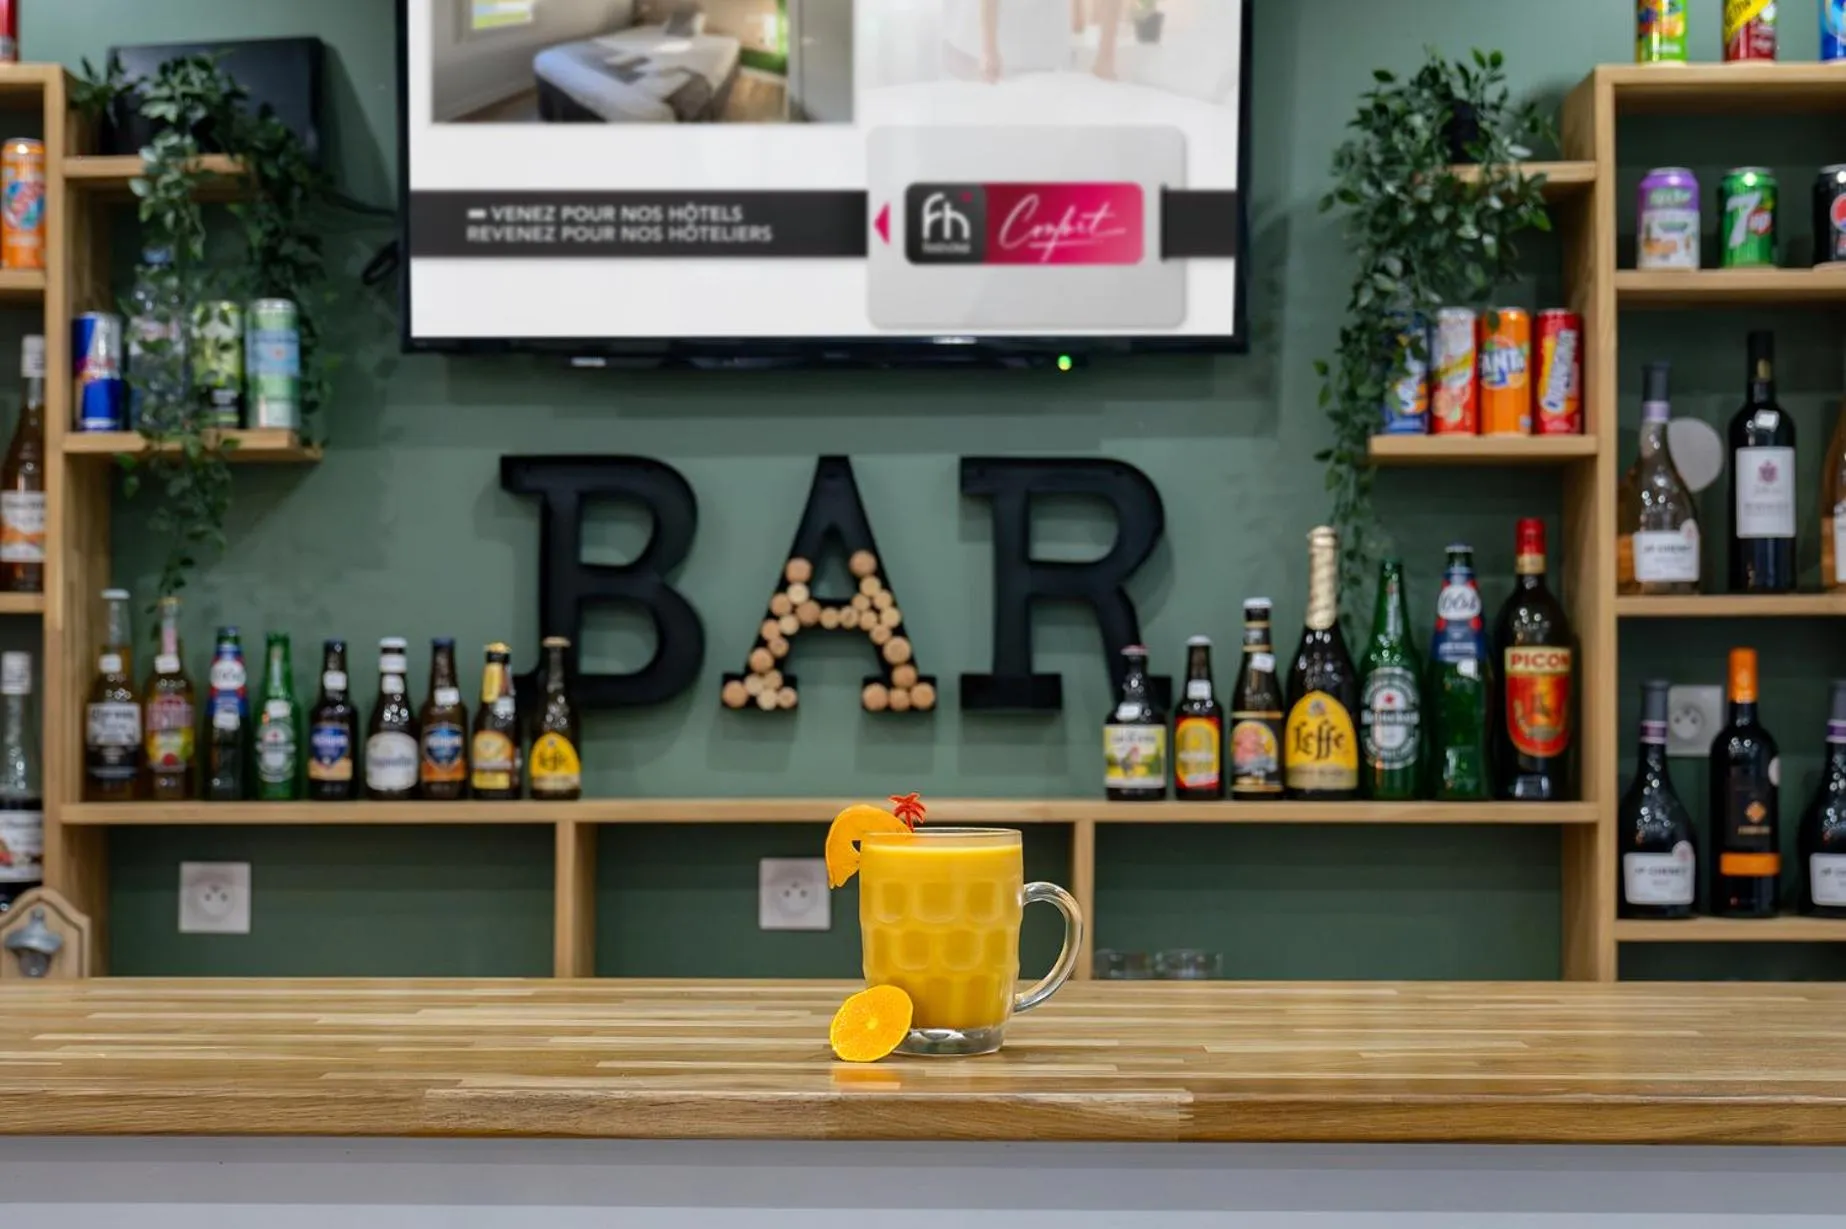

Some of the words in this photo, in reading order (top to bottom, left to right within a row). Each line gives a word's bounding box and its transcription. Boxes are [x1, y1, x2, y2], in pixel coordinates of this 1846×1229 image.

[490, 205, 556, 222] VENEZ
[561, 205, 616, 222] POUR
[620, 205, 664, 222] NOS
[668, 201, 744, 222] HÔTELS
[466, 225, 556, 242] REVENEZ
[561, 225, 616, 242] POUR
[620, 225, 664, 242] NOS
[668, 221, 774, 242] HÔTELIERS
[500, 454, 1171, 711] BAR
[1510, 652, 1570, 668] PICON
[1294, 723, 1346, 760] Leffe
